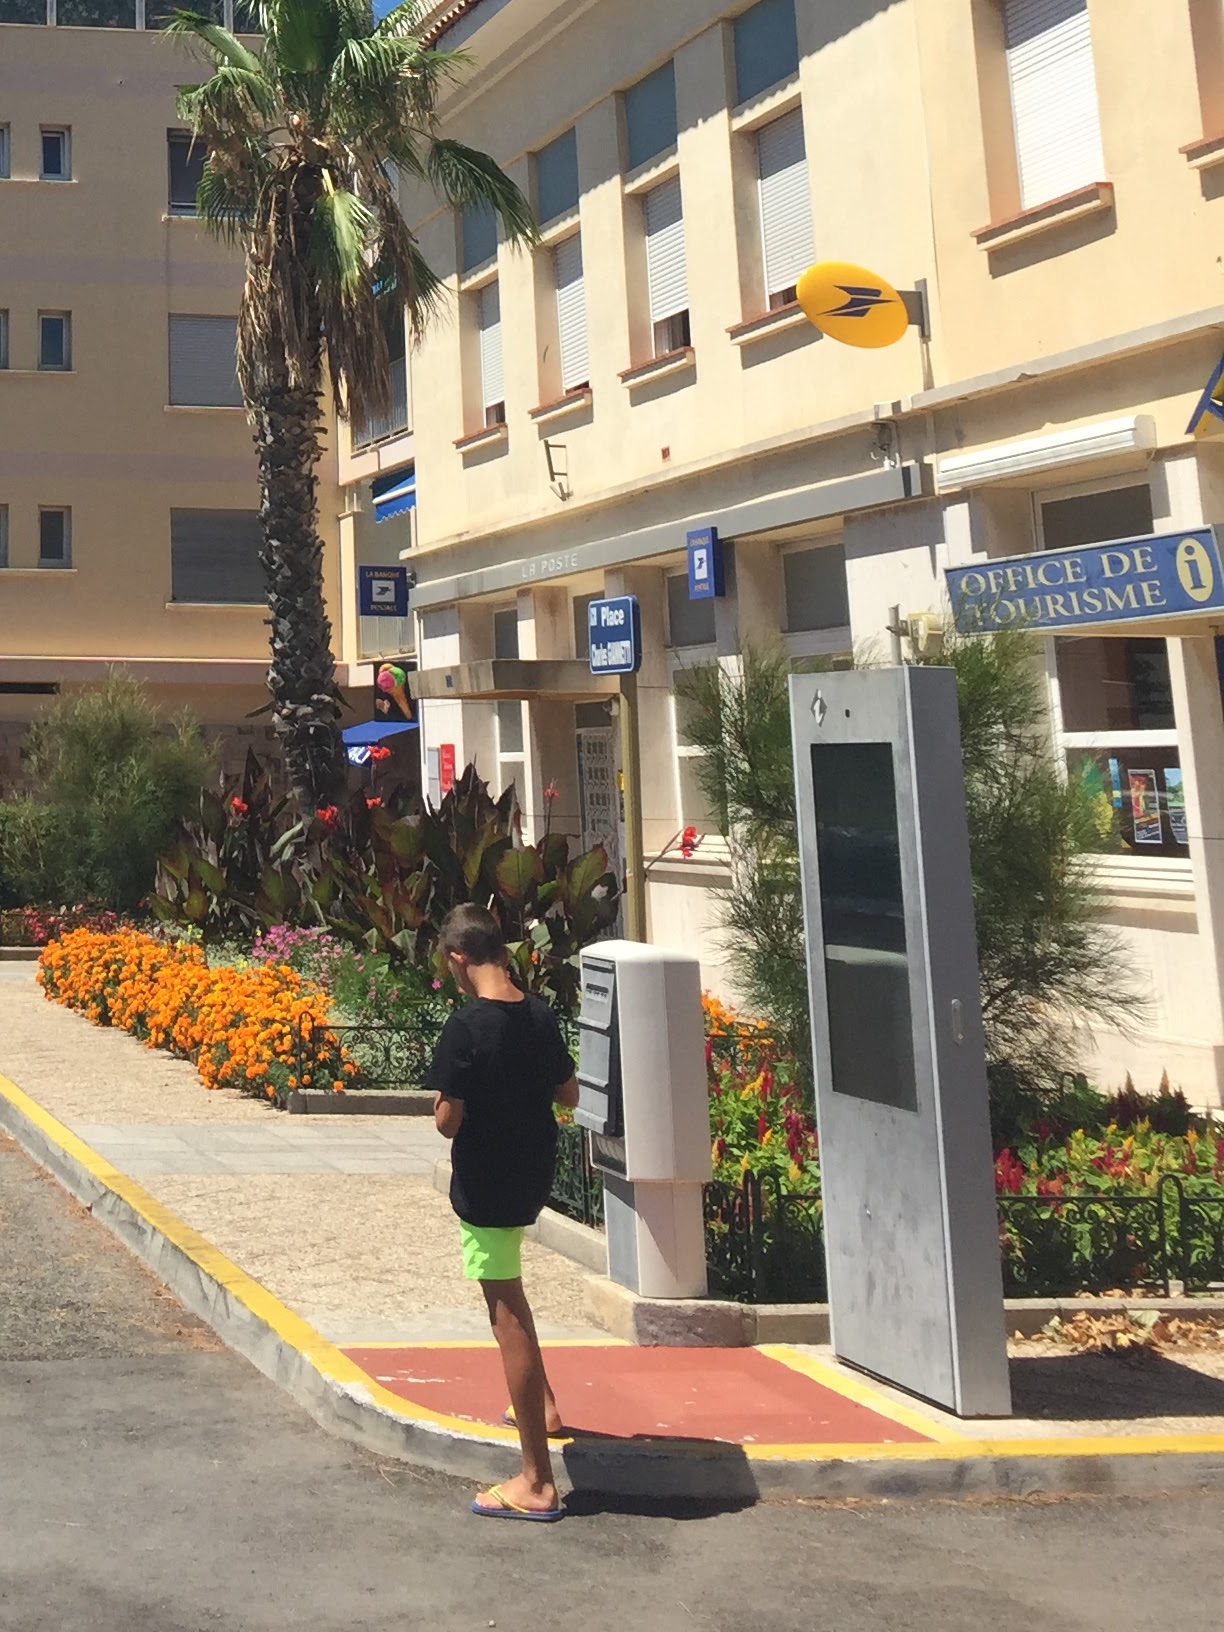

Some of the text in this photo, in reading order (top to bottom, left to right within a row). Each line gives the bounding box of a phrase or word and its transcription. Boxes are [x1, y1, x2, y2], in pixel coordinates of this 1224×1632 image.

[522, 553, 578, 578] LA POSTE
[960, 546, 1158, 597] OFFICE DE
[601, 606, 625, 627] Place
[964, 579, 1167, 626] TOURISME
